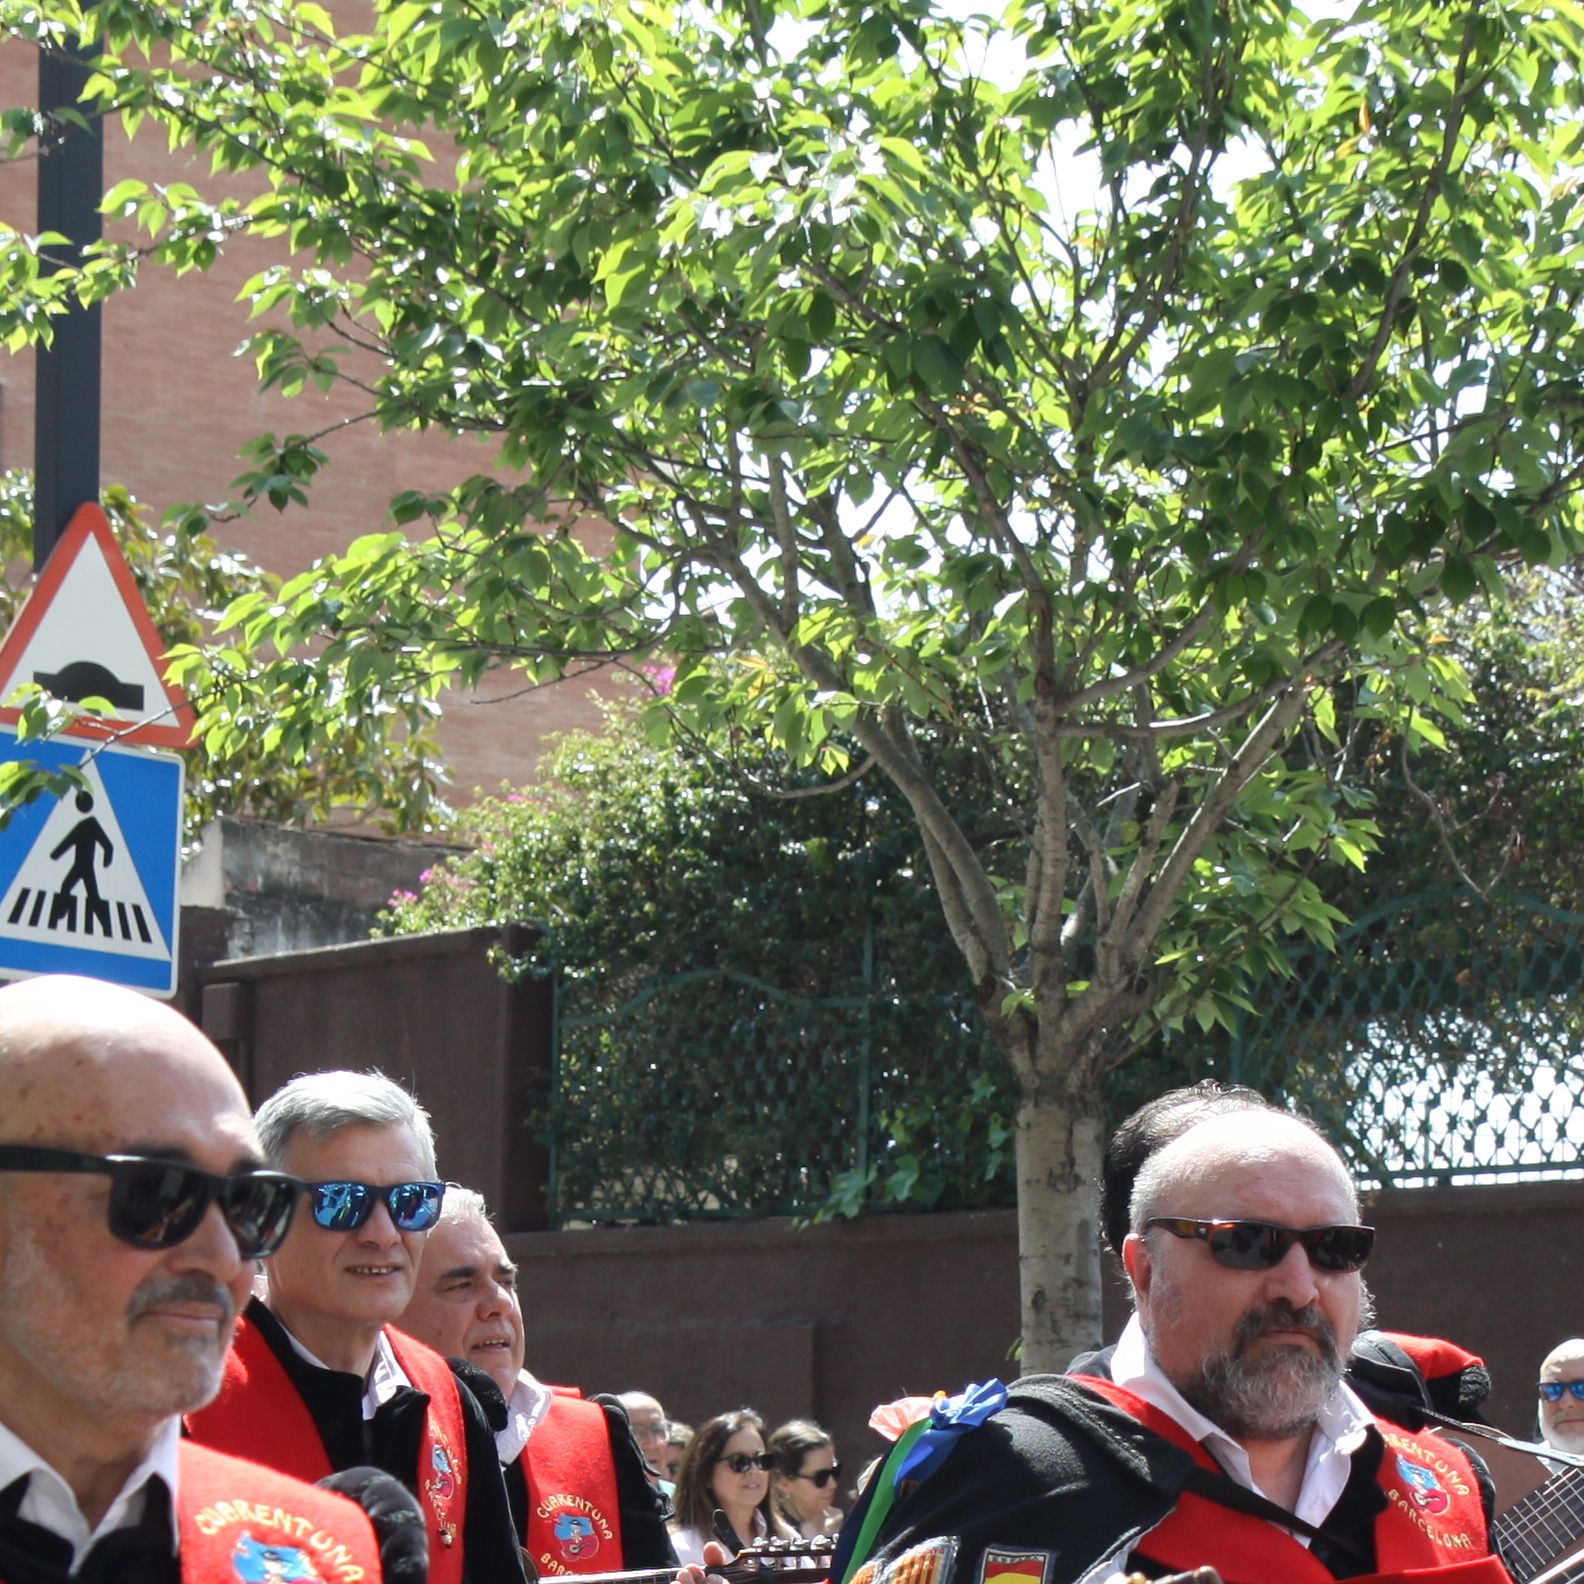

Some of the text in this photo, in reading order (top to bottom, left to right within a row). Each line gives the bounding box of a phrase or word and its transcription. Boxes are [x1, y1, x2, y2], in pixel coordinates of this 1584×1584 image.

[194, 1498, 365, 1583] CUARENTUNA
[537, 1494, 613, 1540] CUARENTUNA
[1388, 1489, 1472, 1549] BARCELONA
